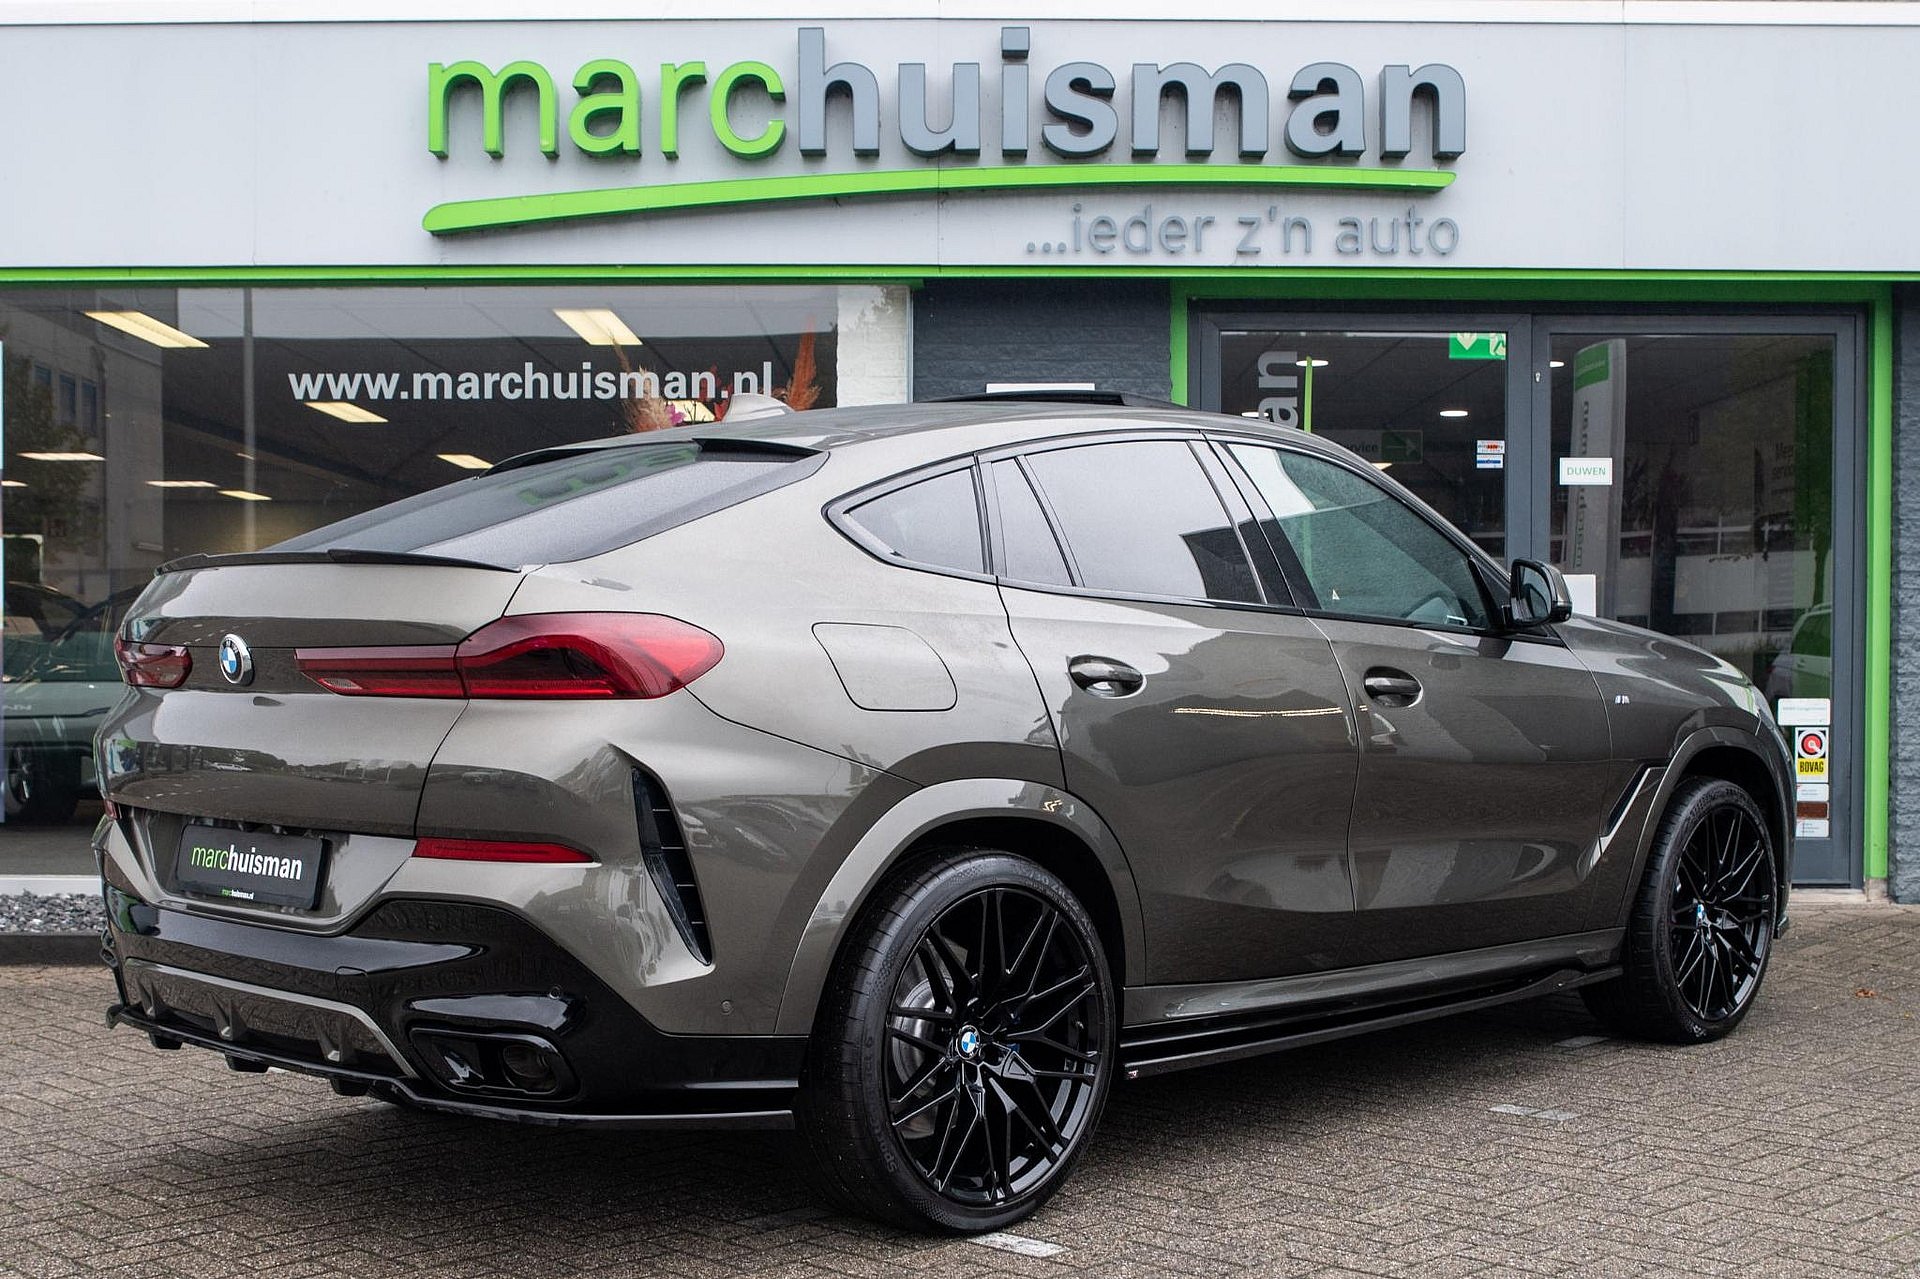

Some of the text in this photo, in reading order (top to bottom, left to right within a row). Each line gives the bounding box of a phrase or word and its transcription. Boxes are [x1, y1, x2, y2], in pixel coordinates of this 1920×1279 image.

[428, 27, 1466, 159] marchuisman
[1236, 205, 1313, 256] z'n
[1336, 204, 1460, 256] auto
[287, 361, 773, 400] www.marchuisman.nl
[1567, 466, 1606, 476] DUWEN
[1799, 761, 1824, 773] BOVAG
[191, 844, 303, 880] marchuisman
